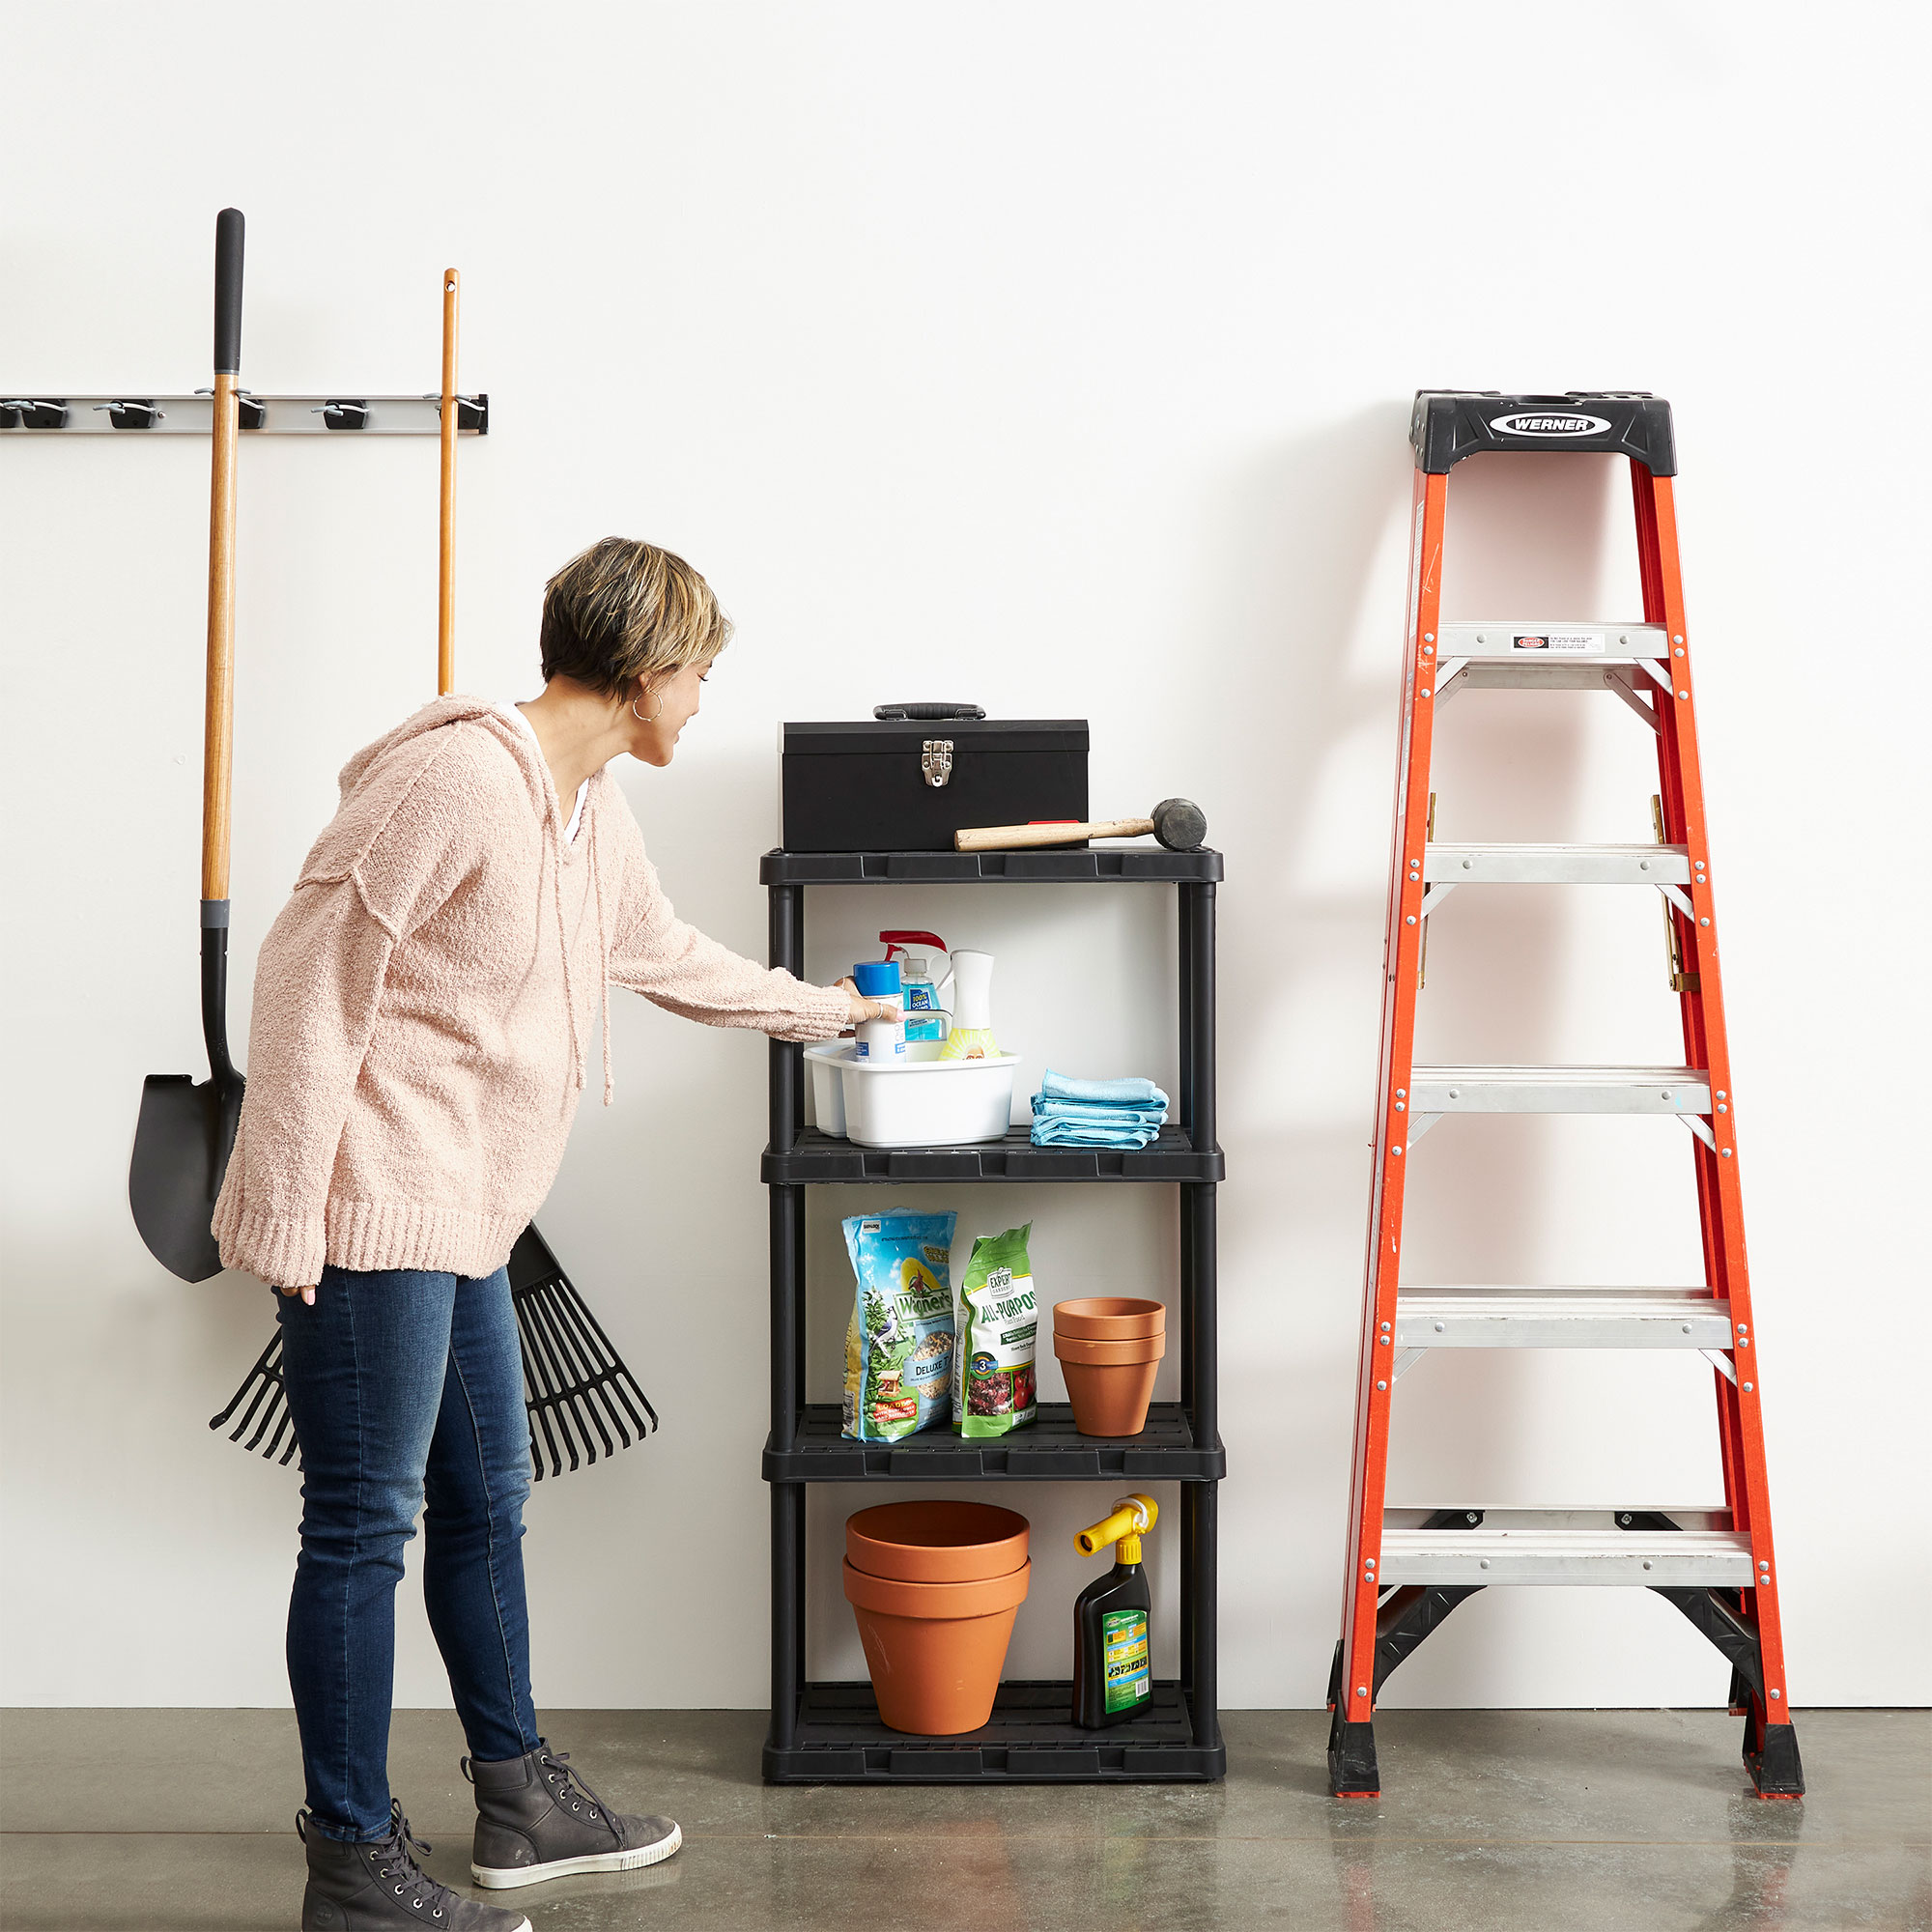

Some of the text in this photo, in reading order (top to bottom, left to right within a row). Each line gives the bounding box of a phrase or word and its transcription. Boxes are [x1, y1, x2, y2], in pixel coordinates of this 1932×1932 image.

[1515, 418, 1589, 431] WERNER
[898, 1293, 953, 1316] Wagner's
[916, 1360, 943, 1376] DELUXE
[979, 1360, 986, 1370] 3
